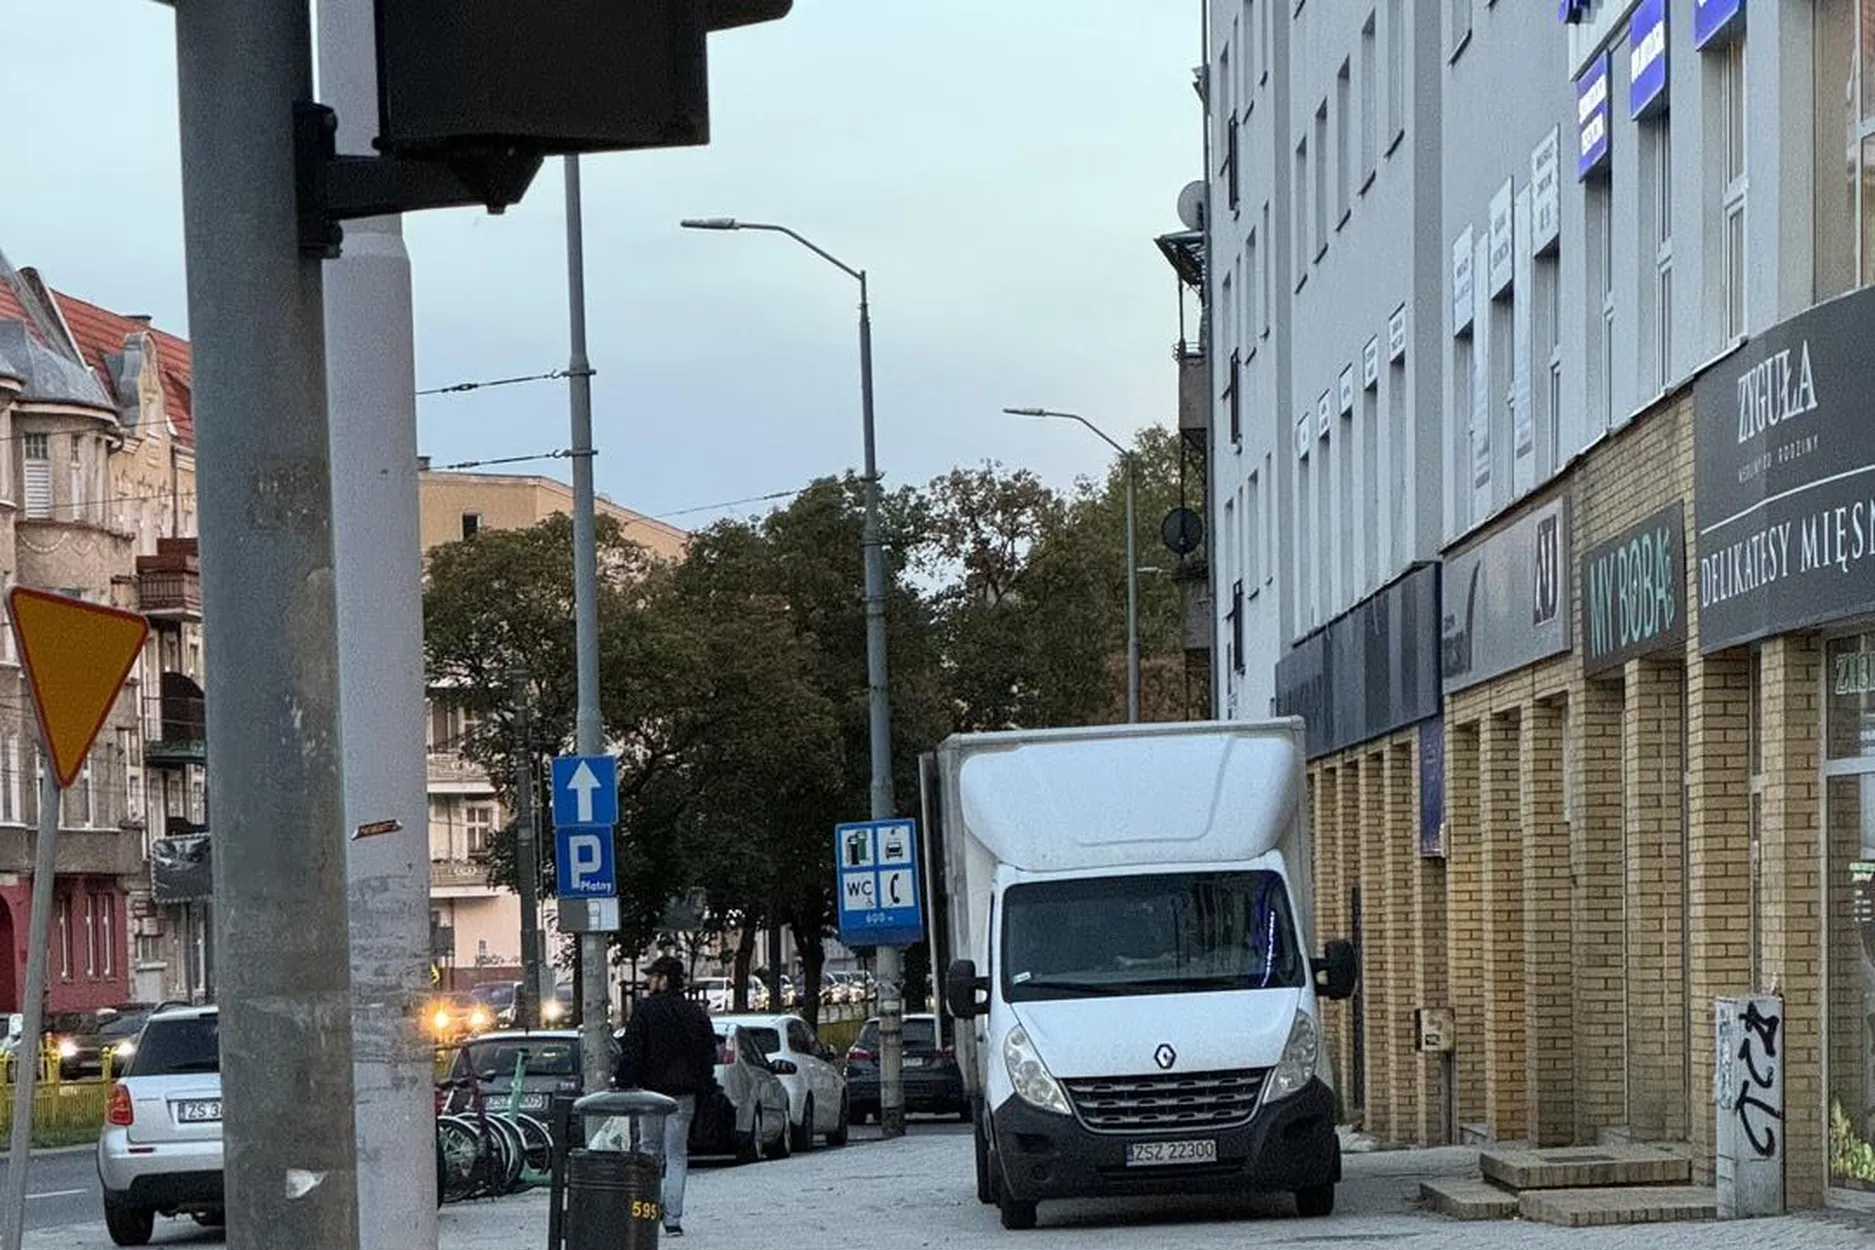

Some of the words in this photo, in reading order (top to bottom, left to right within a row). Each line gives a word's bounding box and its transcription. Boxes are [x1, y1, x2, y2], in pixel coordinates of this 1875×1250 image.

[1738, 339, 1818, 444] ZYGUŁA
[1701, 521, 1791, 609] DELIKATESY
[1590, 552, 1615, 659] MY
[1618, 527, 1671, 648] BOBA
[569, 834, 602, 889] P
[847, 880, 873, 897] WC
[188, 1103, 206, 1118] ZS
[211, 1102, 223, 1117] 3
[1136, 1145, 1164, 1161] ZSZ
[1168, 1142, 1214, 1159] 22300
[632, 1201, 657, 1220] 595
